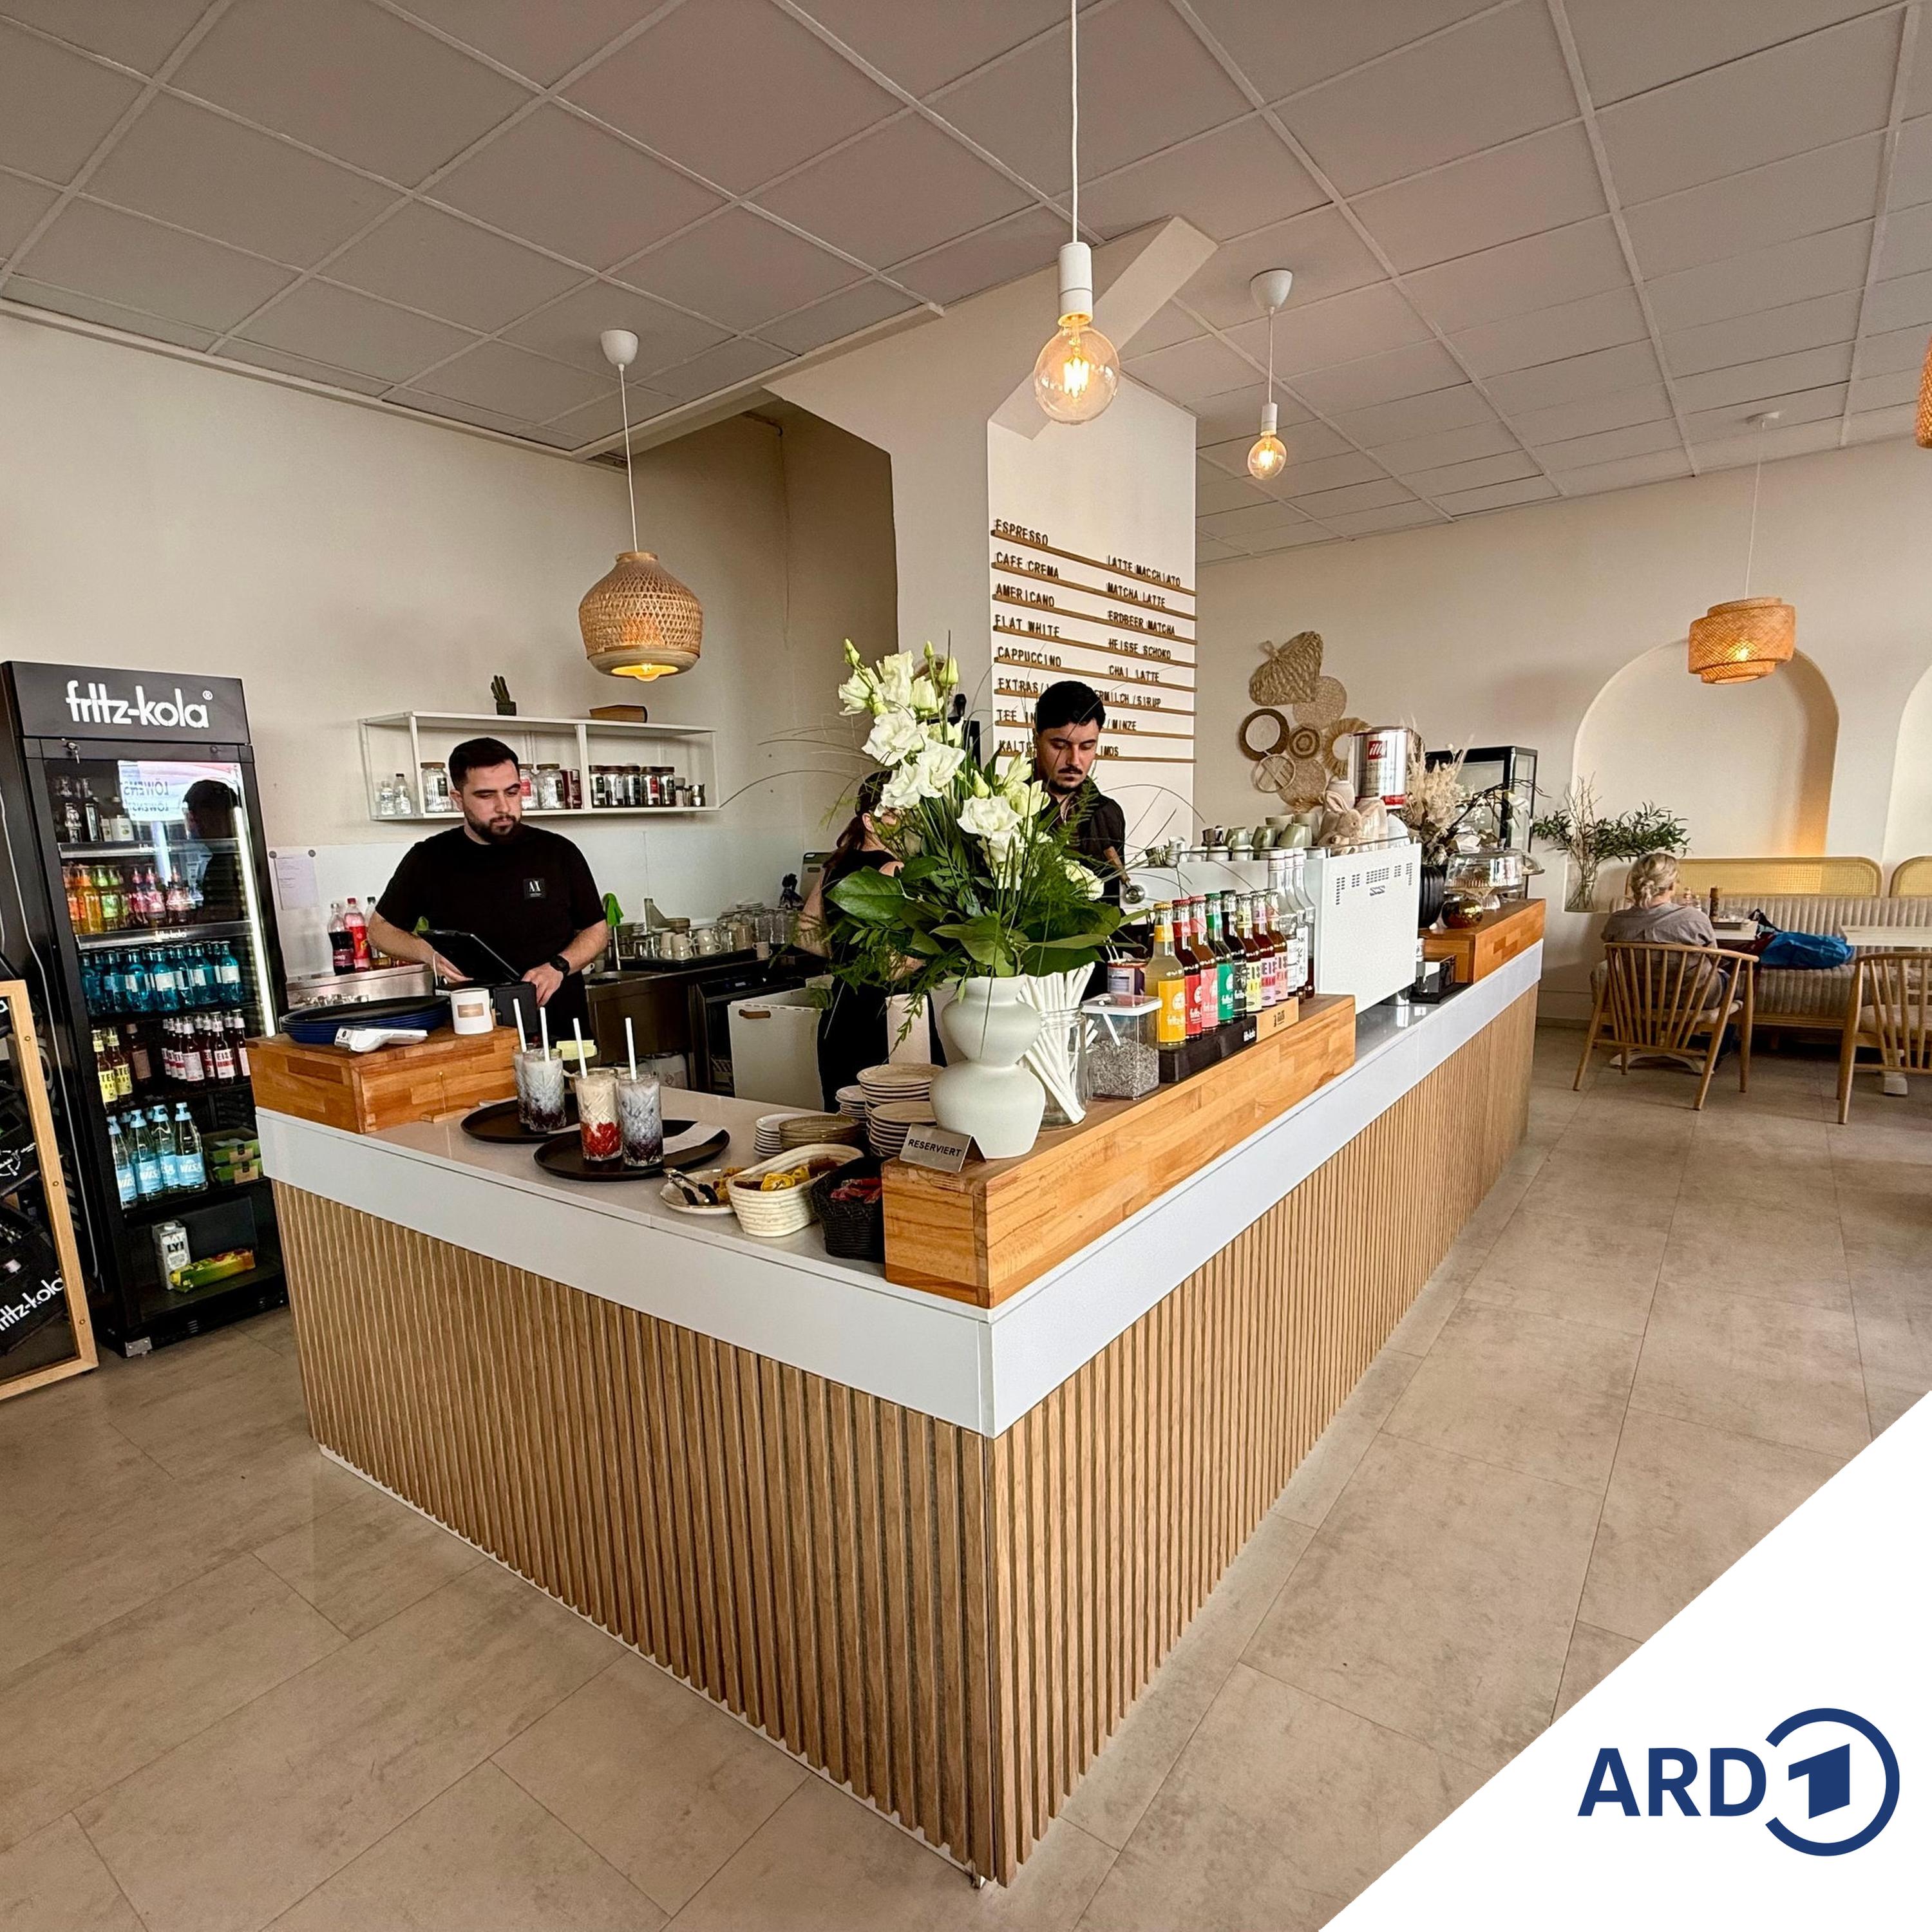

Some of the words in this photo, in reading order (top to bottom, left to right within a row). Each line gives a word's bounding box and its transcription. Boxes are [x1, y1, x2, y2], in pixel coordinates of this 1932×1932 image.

[994, 518, 1048, 546] ESPRESSO
[996, 551, 1023, 569] CAFE
[1028, 560, 1059, 579] CREMA
[1107, 554, 1133, 573] LATTE
[1135, 564, 1181, 587] MACCHIATO
[996, 582, 1055, 607] AMERICANO
[1106, 582, 1139, 601] MATCHA
[1142, 592, 1166, 608] LATTE
[995, 614, 1023, 630] FLAT
[1028, 620, 1060, 638] WHITE
[1107, 610, 1144, 629] ERDBEER
[1148, 620, 1175, 636] MATCHA
[998, 646, 1062, 667] CAPPUCCINO
[1108, 638, 1139, 654] HEISSE
[1142, 645, 1172, 660] SCHOKO
[998, 677, 1050, 694] EXTRAS/
[1108, 665, 1128, 678] CHAI
[1135, 668, 1160, 683] LATTE
[66, 680, 209, 728] fritz-kola
[996, 709, 1017, 722] TEE
[908, 1139, 962, 1157] RESERVIERT
[0, 1277, 66, 1332] ritz-kola
